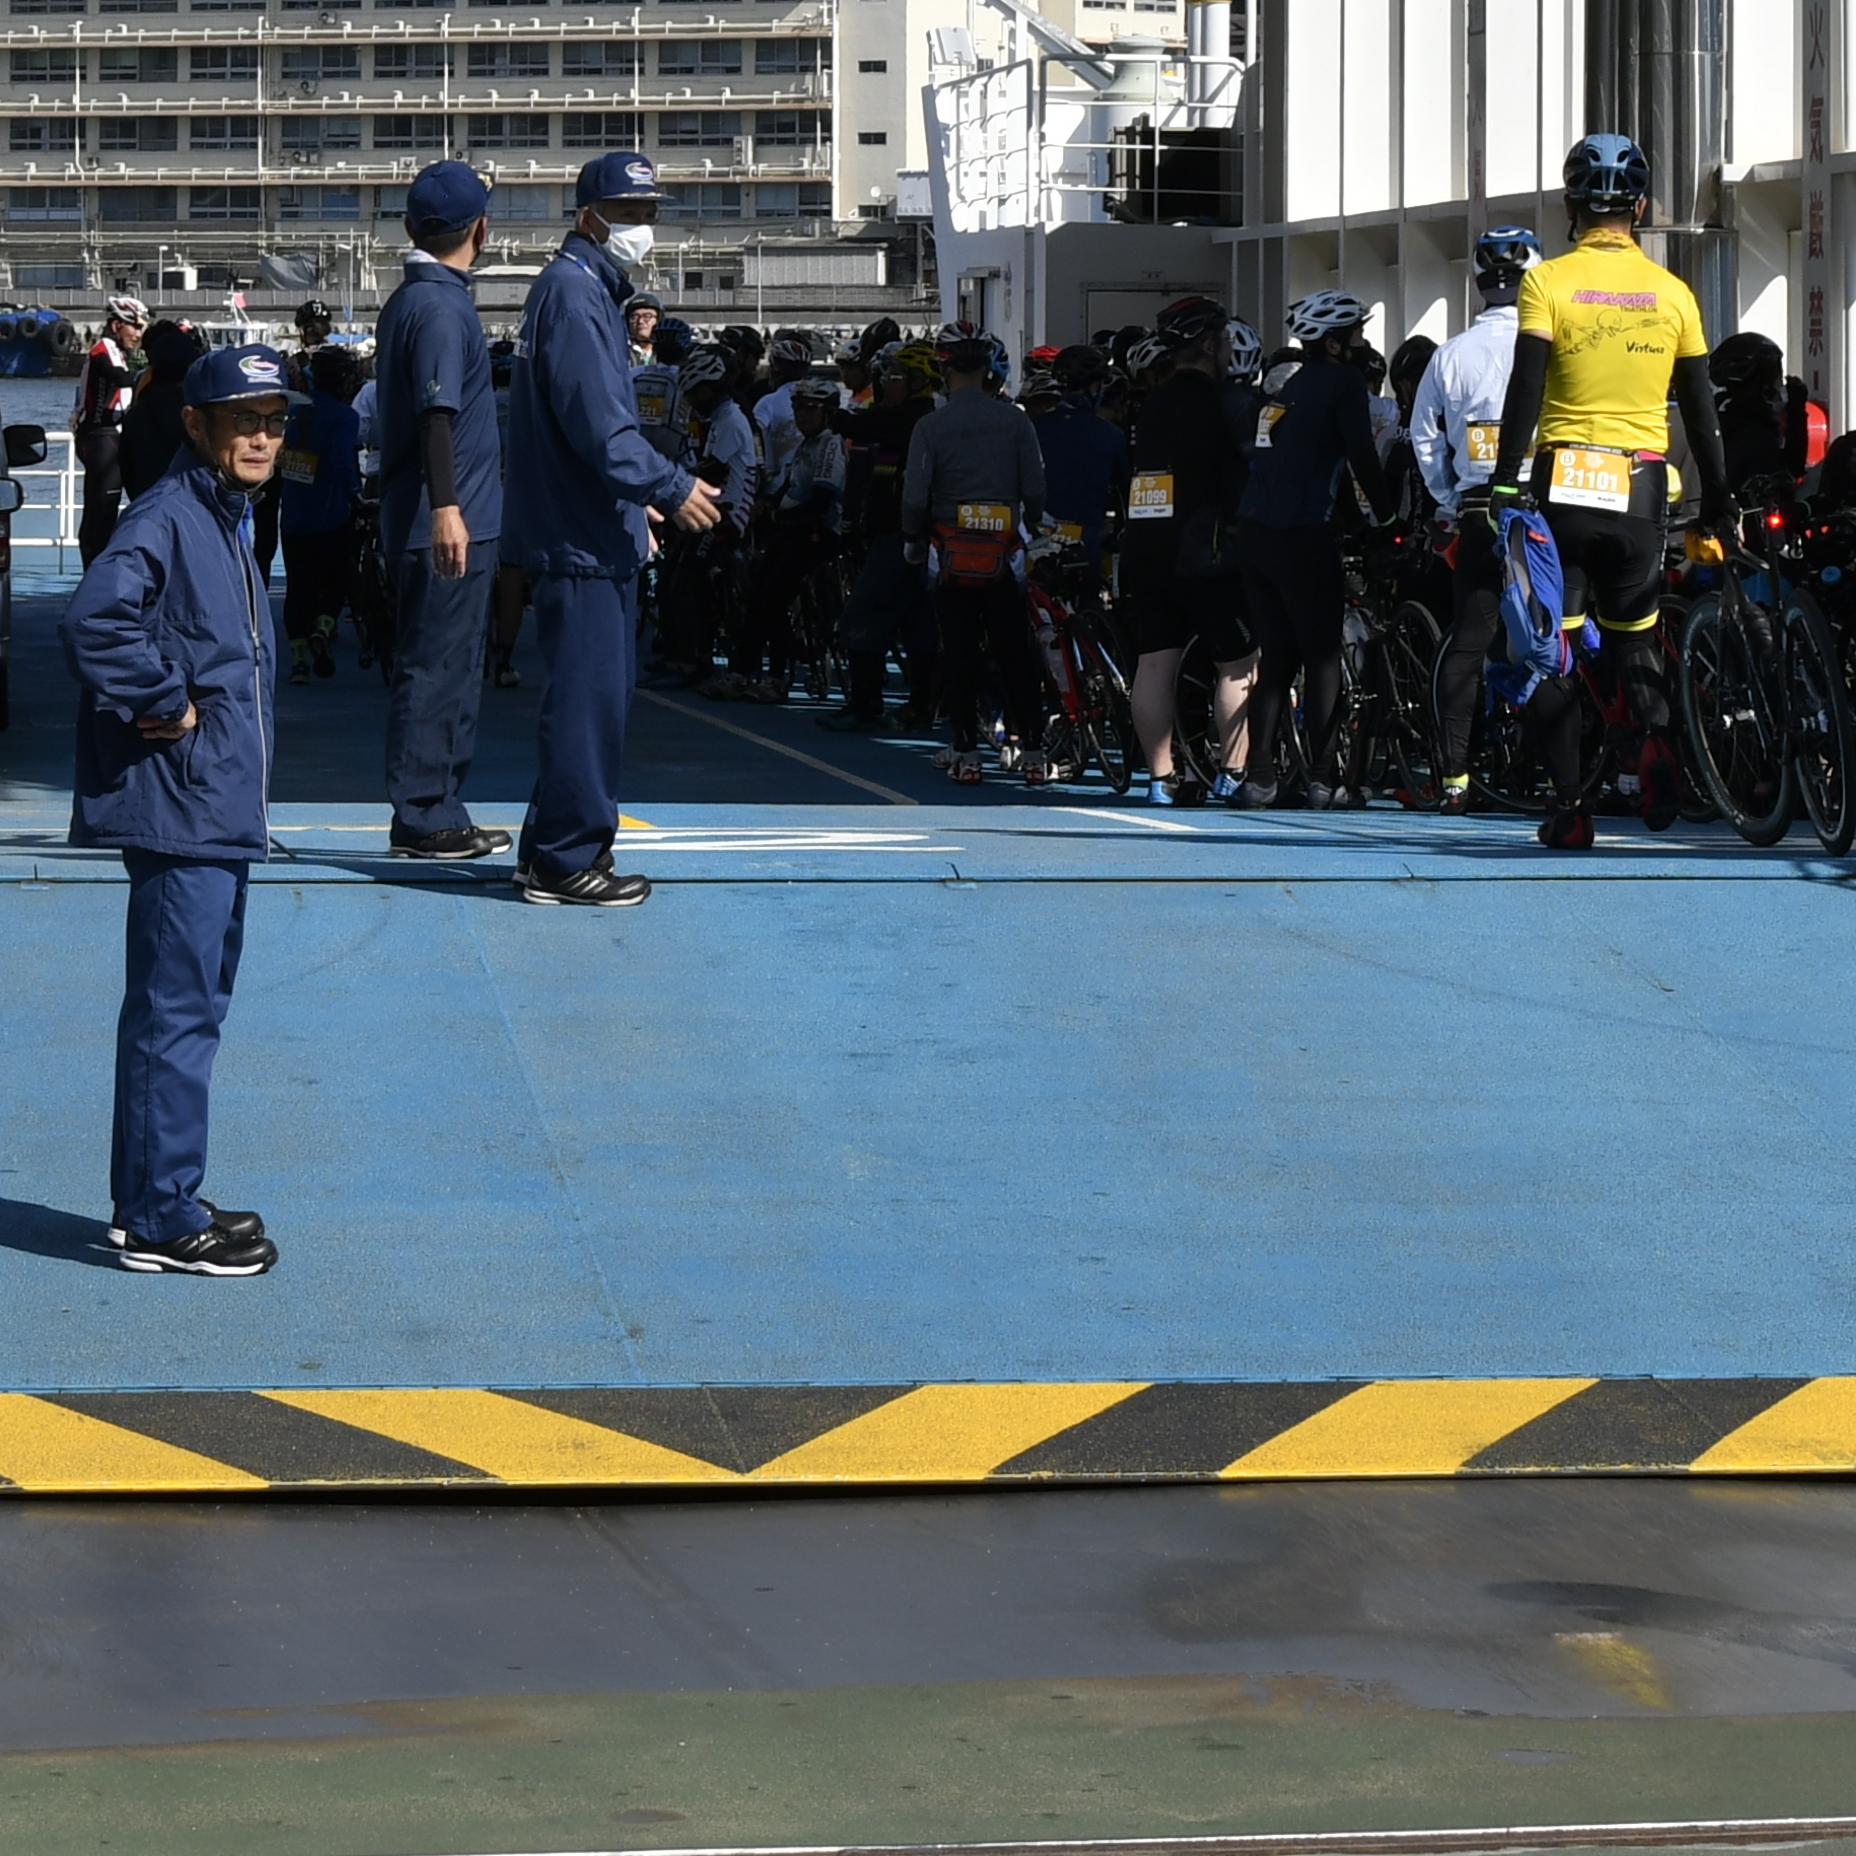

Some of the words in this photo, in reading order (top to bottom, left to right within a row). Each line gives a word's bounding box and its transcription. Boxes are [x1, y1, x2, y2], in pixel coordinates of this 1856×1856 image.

[1808, 2, 1825, 357] 火気厳禁
[1571, 290, 1657, 306] HIRAKATA
[1562, 466, 1618, 492] 21101
[1133, 489, 1167, 505] 21099
[964, 516, 1004, 532] 21310
